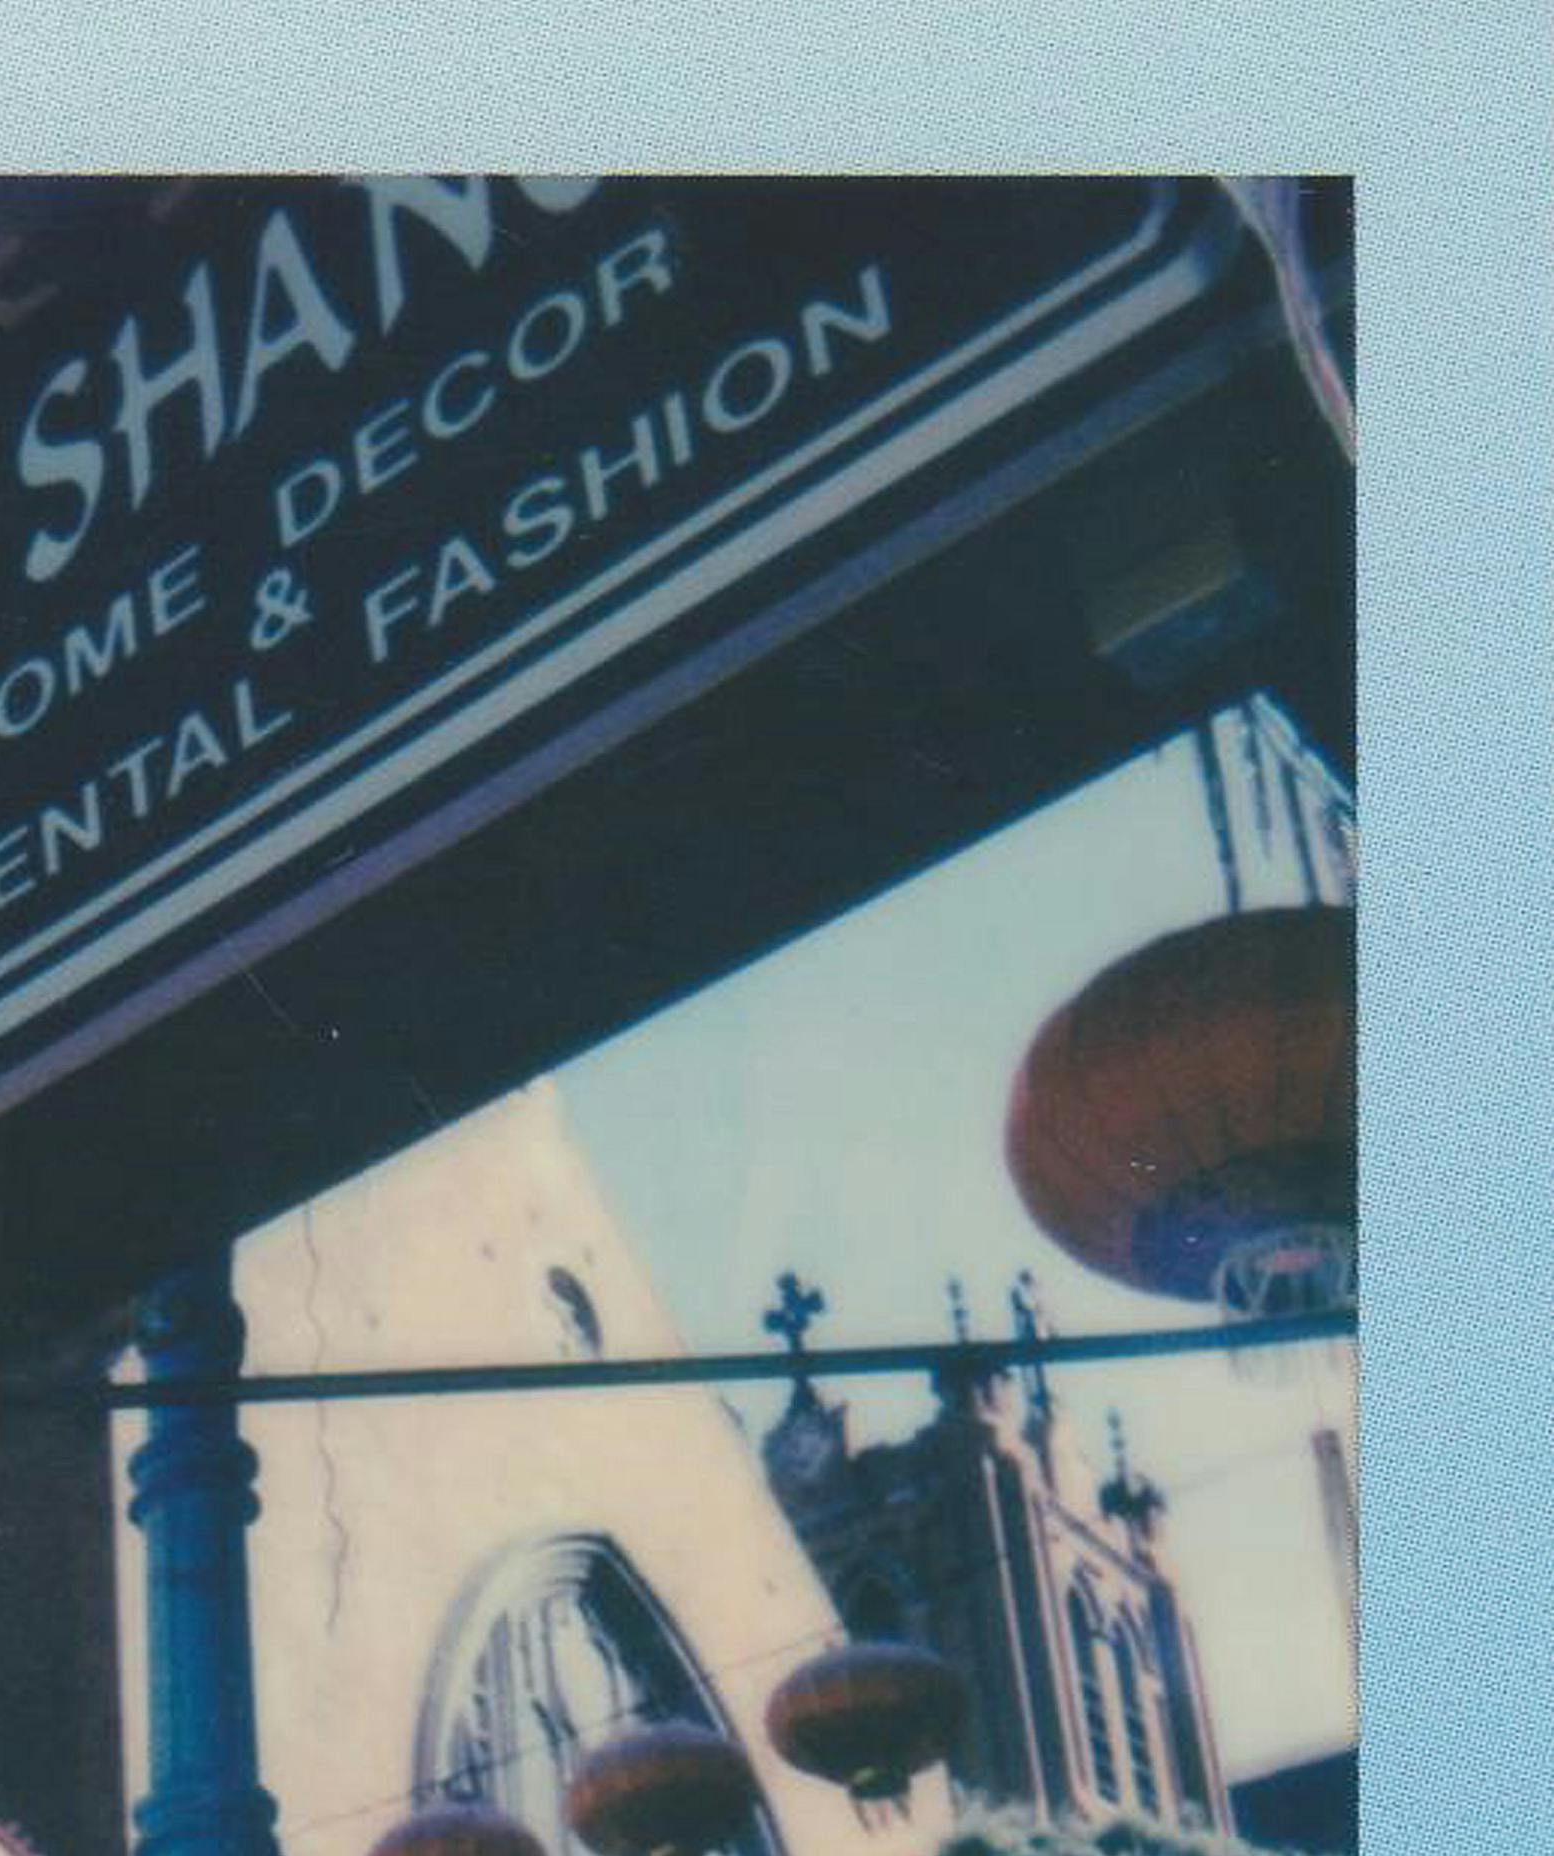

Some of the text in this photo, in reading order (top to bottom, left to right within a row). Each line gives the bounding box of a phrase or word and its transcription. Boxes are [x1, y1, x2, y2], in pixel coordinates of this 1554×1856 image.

[17, 175, 602, 582] SHAN
[274, 228, 674, 549] DECOR
[362, 264, 892, 663] FASHION
[249, 566, 314, 652] &
